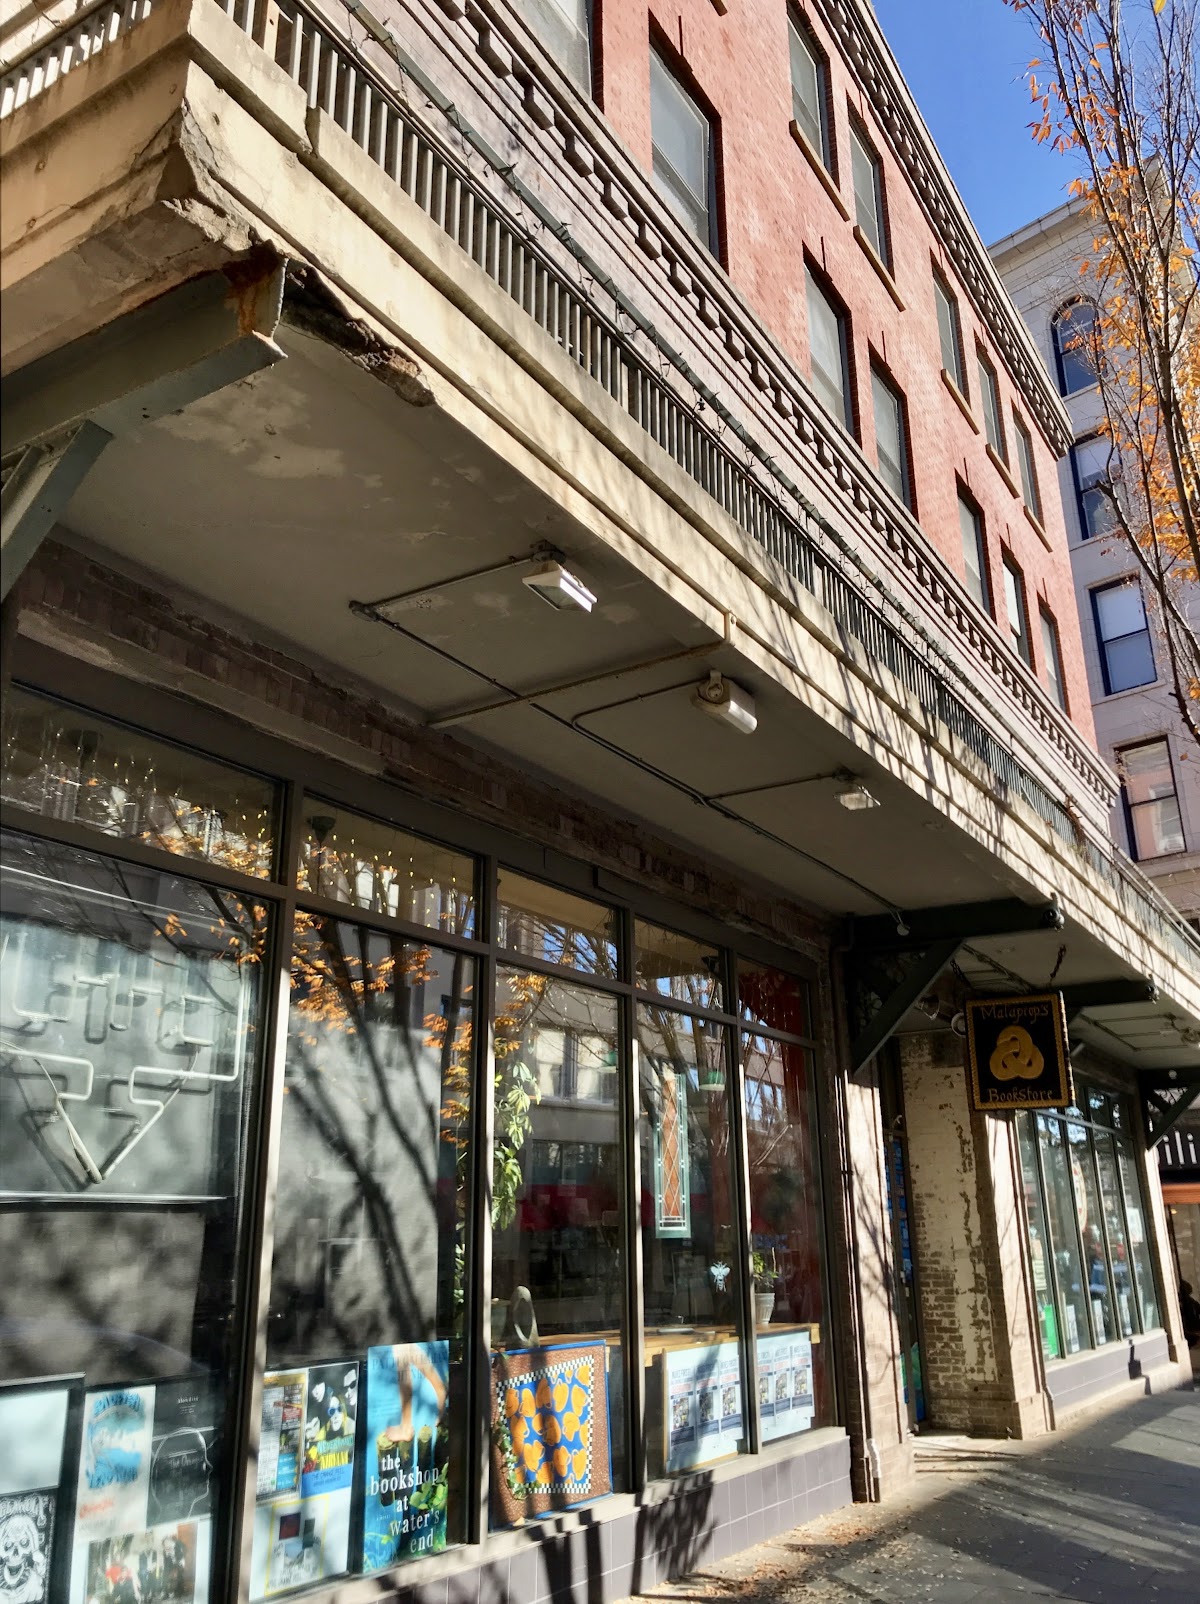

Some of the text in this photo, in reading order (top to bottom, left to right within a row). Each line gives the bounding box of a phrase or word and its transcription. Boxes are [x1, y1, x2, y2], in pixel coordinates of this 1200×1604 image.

[980, 1004, 1049, 1024] Malaprop's
[381, 1454, 401, 1471] the
[370, 1466, 440, 1496] bookshop
[396, 1495, 409, 1513] at
[389, 1507, 440, 1537] water's
[410, 1528, 434, 1554] end
